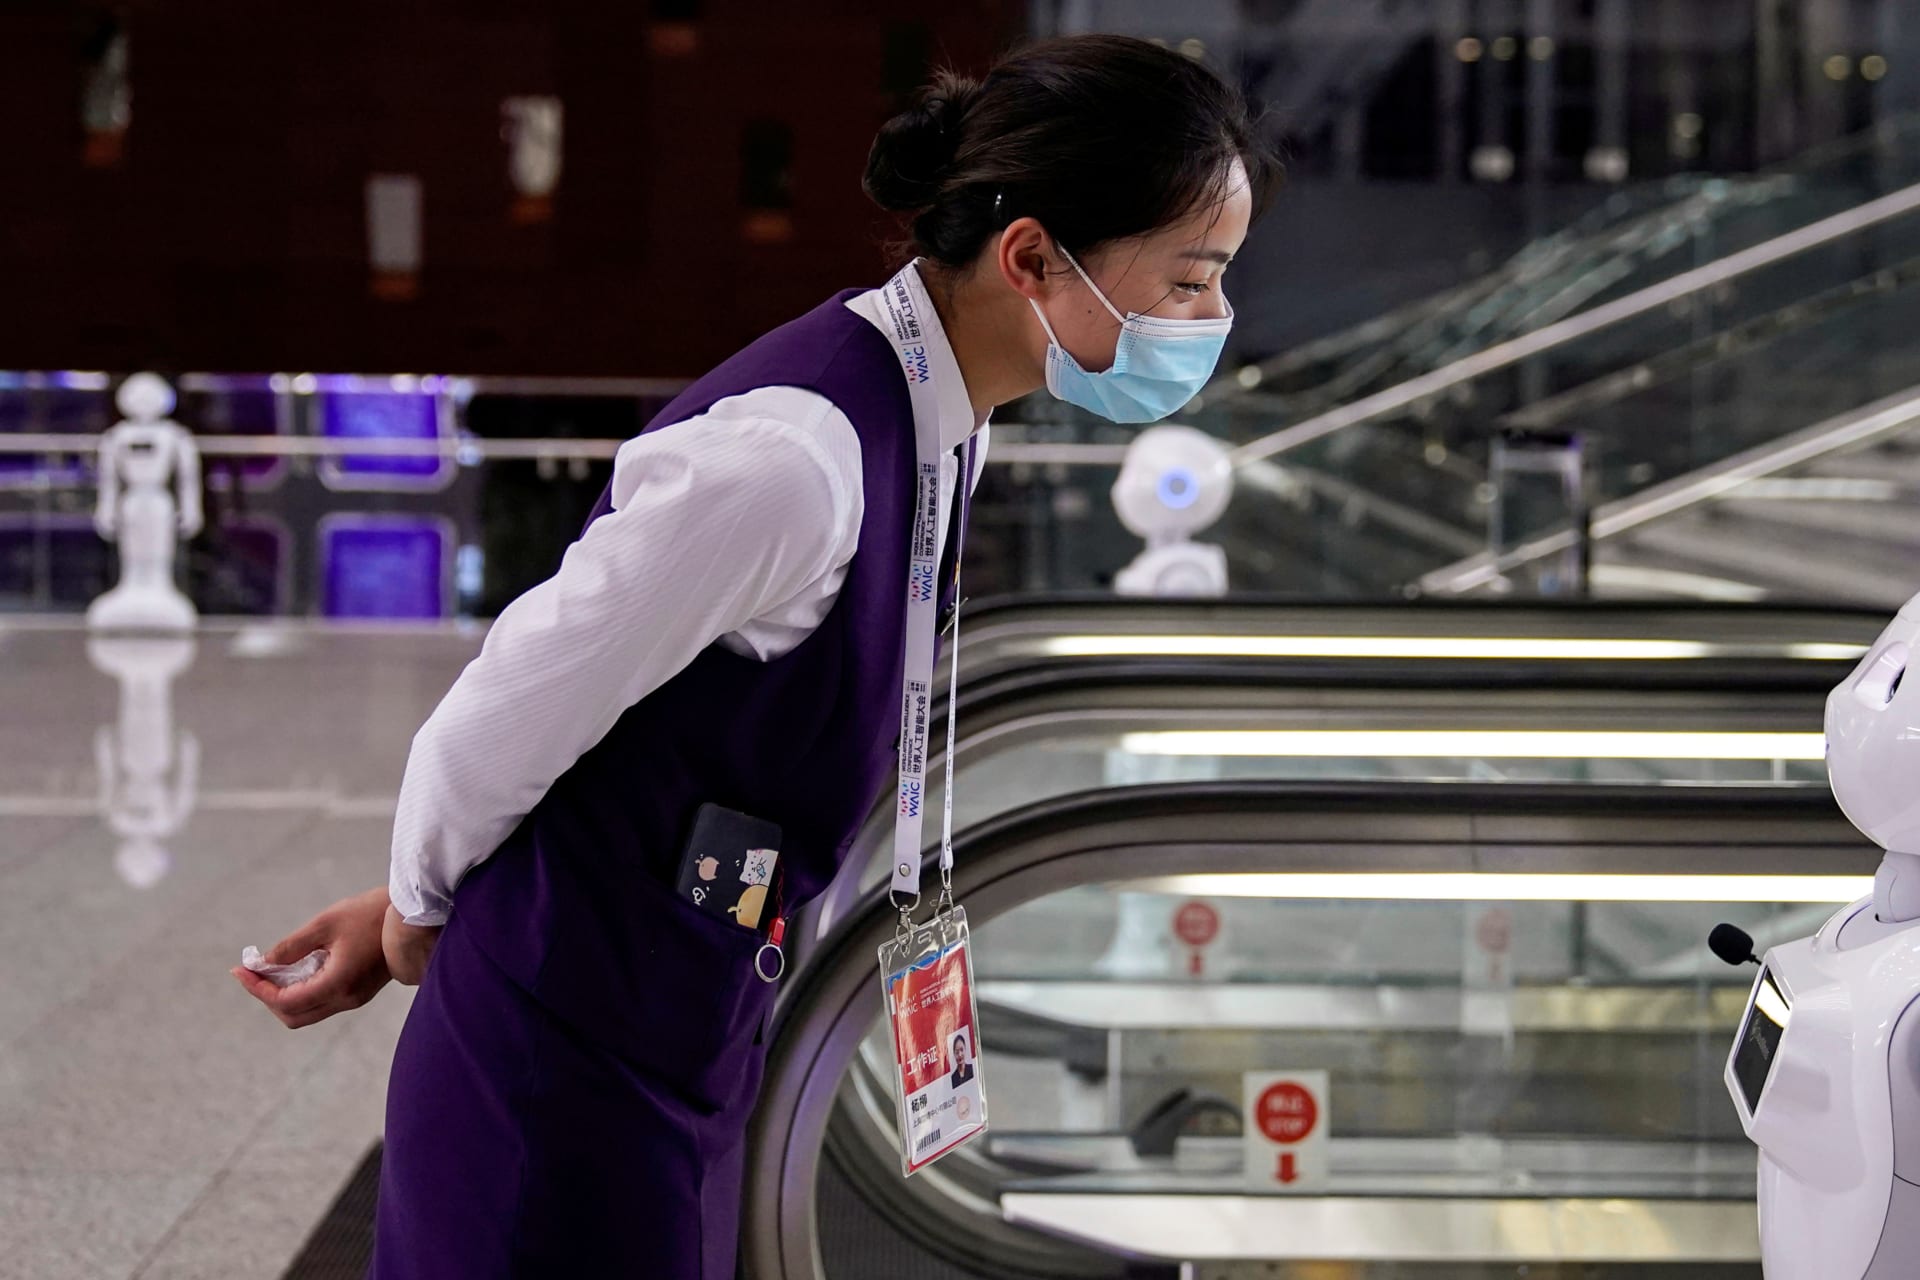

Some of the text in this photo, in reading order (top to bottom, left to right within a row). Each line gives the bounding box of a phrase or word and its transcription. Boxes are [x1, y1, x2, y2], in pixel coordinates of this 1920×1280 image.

[893, 278, 921, 338] 世界人工智能大会
[913, 345, 930, 384] WAIC
[925, 476, 937, 557] 世界人工智能大会
[921, 565, 934, 602] WAIC
[912, 695, 926, 774] 世界人工智能大会
[908, 781, 921, 818] WAIC
[906, 1045, 939, 1076] 工作证
[1267, 1118, 1308, 1136] STOP
